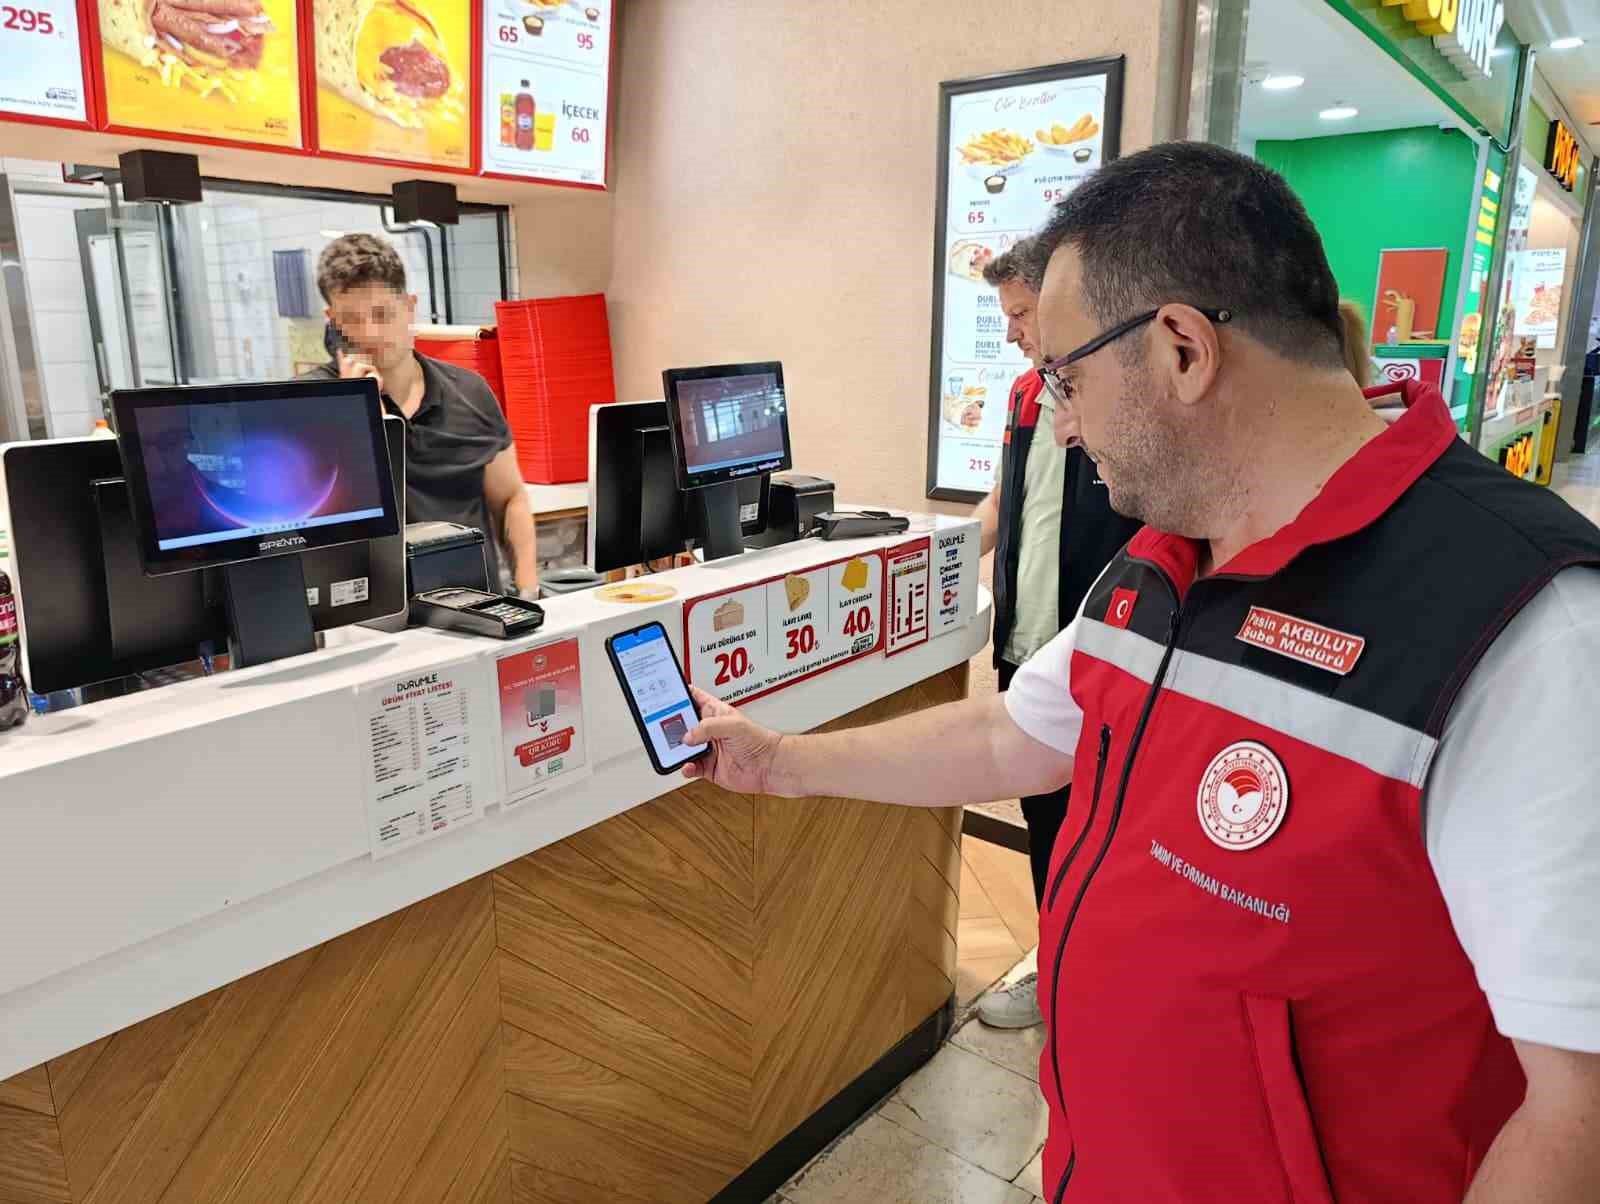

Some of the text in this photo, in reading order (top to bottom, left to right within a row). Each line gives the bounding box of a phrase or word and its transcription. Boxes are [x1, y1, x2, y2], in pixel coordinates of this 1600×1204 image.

[2, 6, 54, 34] 295
[499, 25, 518, 43] 65
[577, 33, 594, 49] 95
[562, 100, 599, 120] İÇECEK
[571, 127, 590, 143] 60
[1044, 188, 1063, 202] 95
[968, 212, 985, 224] 65
[968, 458, 991, 471] 215
[259, 536, 306, 551] SPENTA
[1247, 612, 1356, 655] Yasin AKBULUT
[1150, 839, 1291, 923] TARIM VE ORMAN BAKANLIĞI
